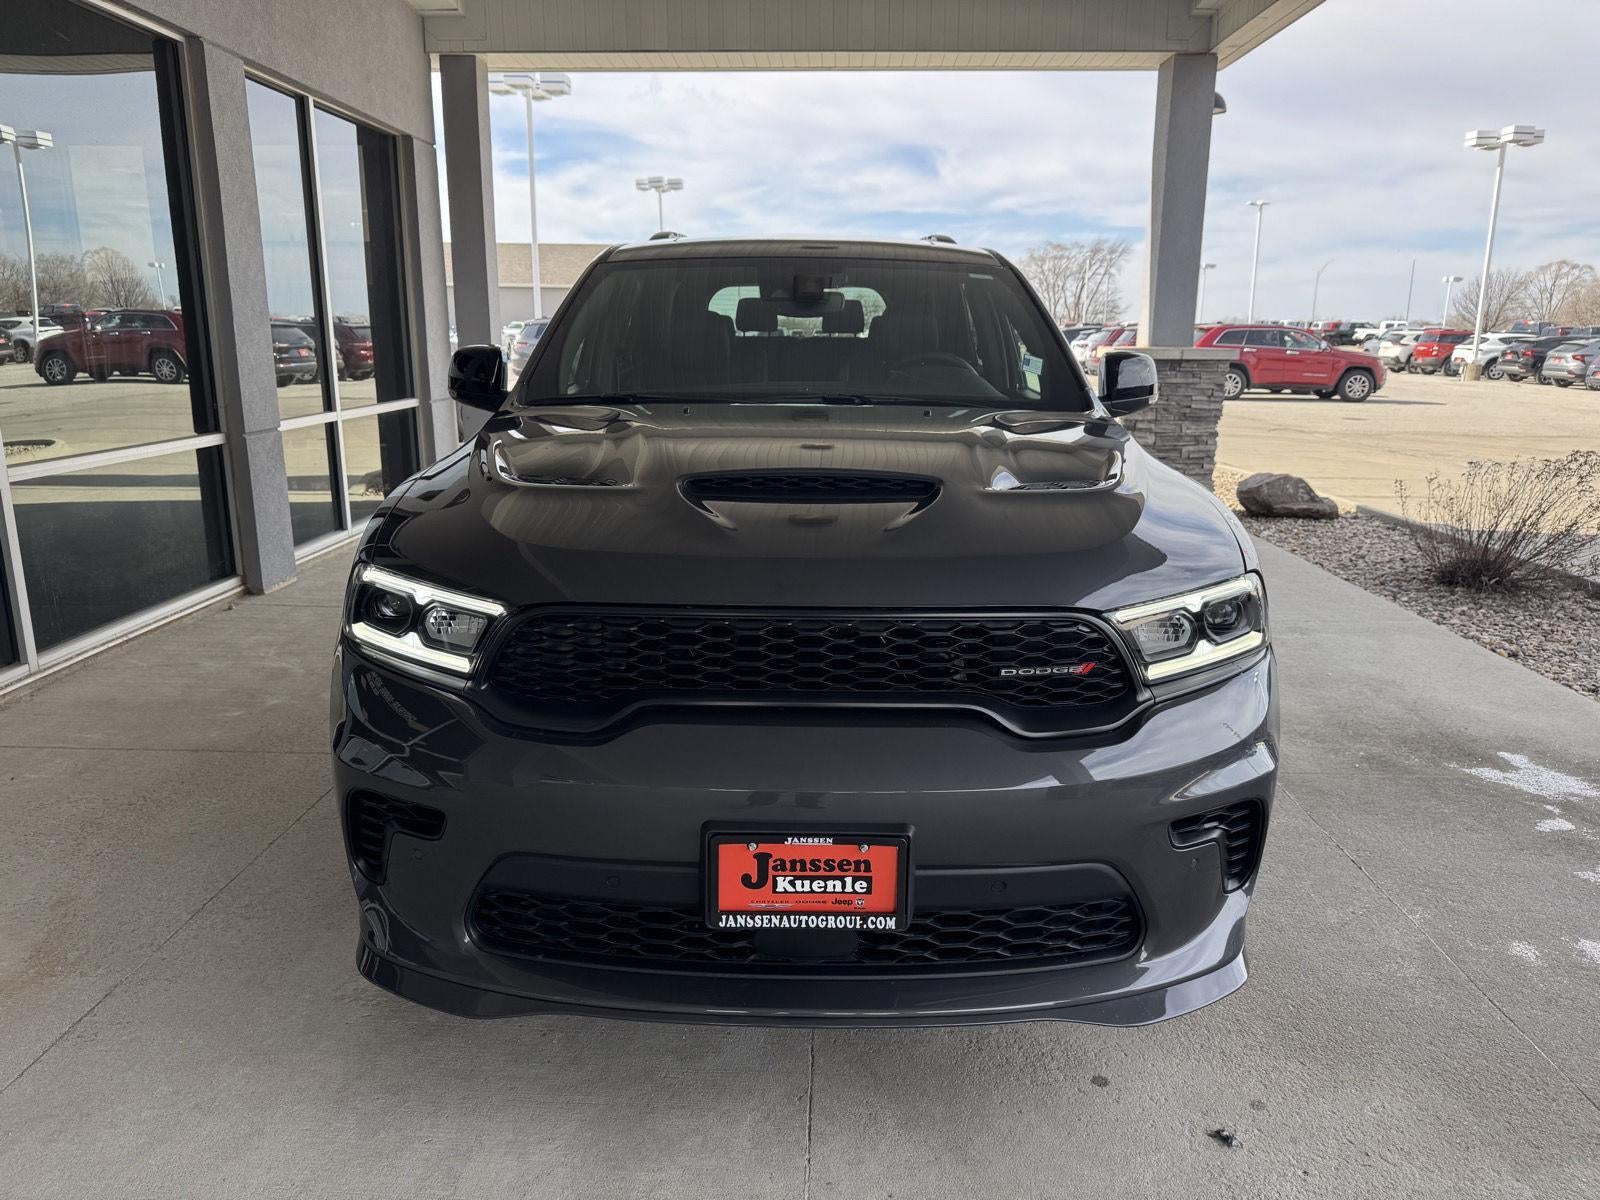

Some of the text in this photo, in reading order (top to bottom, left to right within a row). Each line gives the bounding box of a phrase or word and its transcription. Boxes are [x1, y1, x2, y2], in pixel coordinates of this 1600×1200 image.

[1000, 665, 1084, 676] DODGE
[784, 837, 833, 845] JANSSEN
[741, 852, 872, 889] Janssen
[775, 876, 868, 893] Kuenle
[831, 897, 854, 907] Jeep
